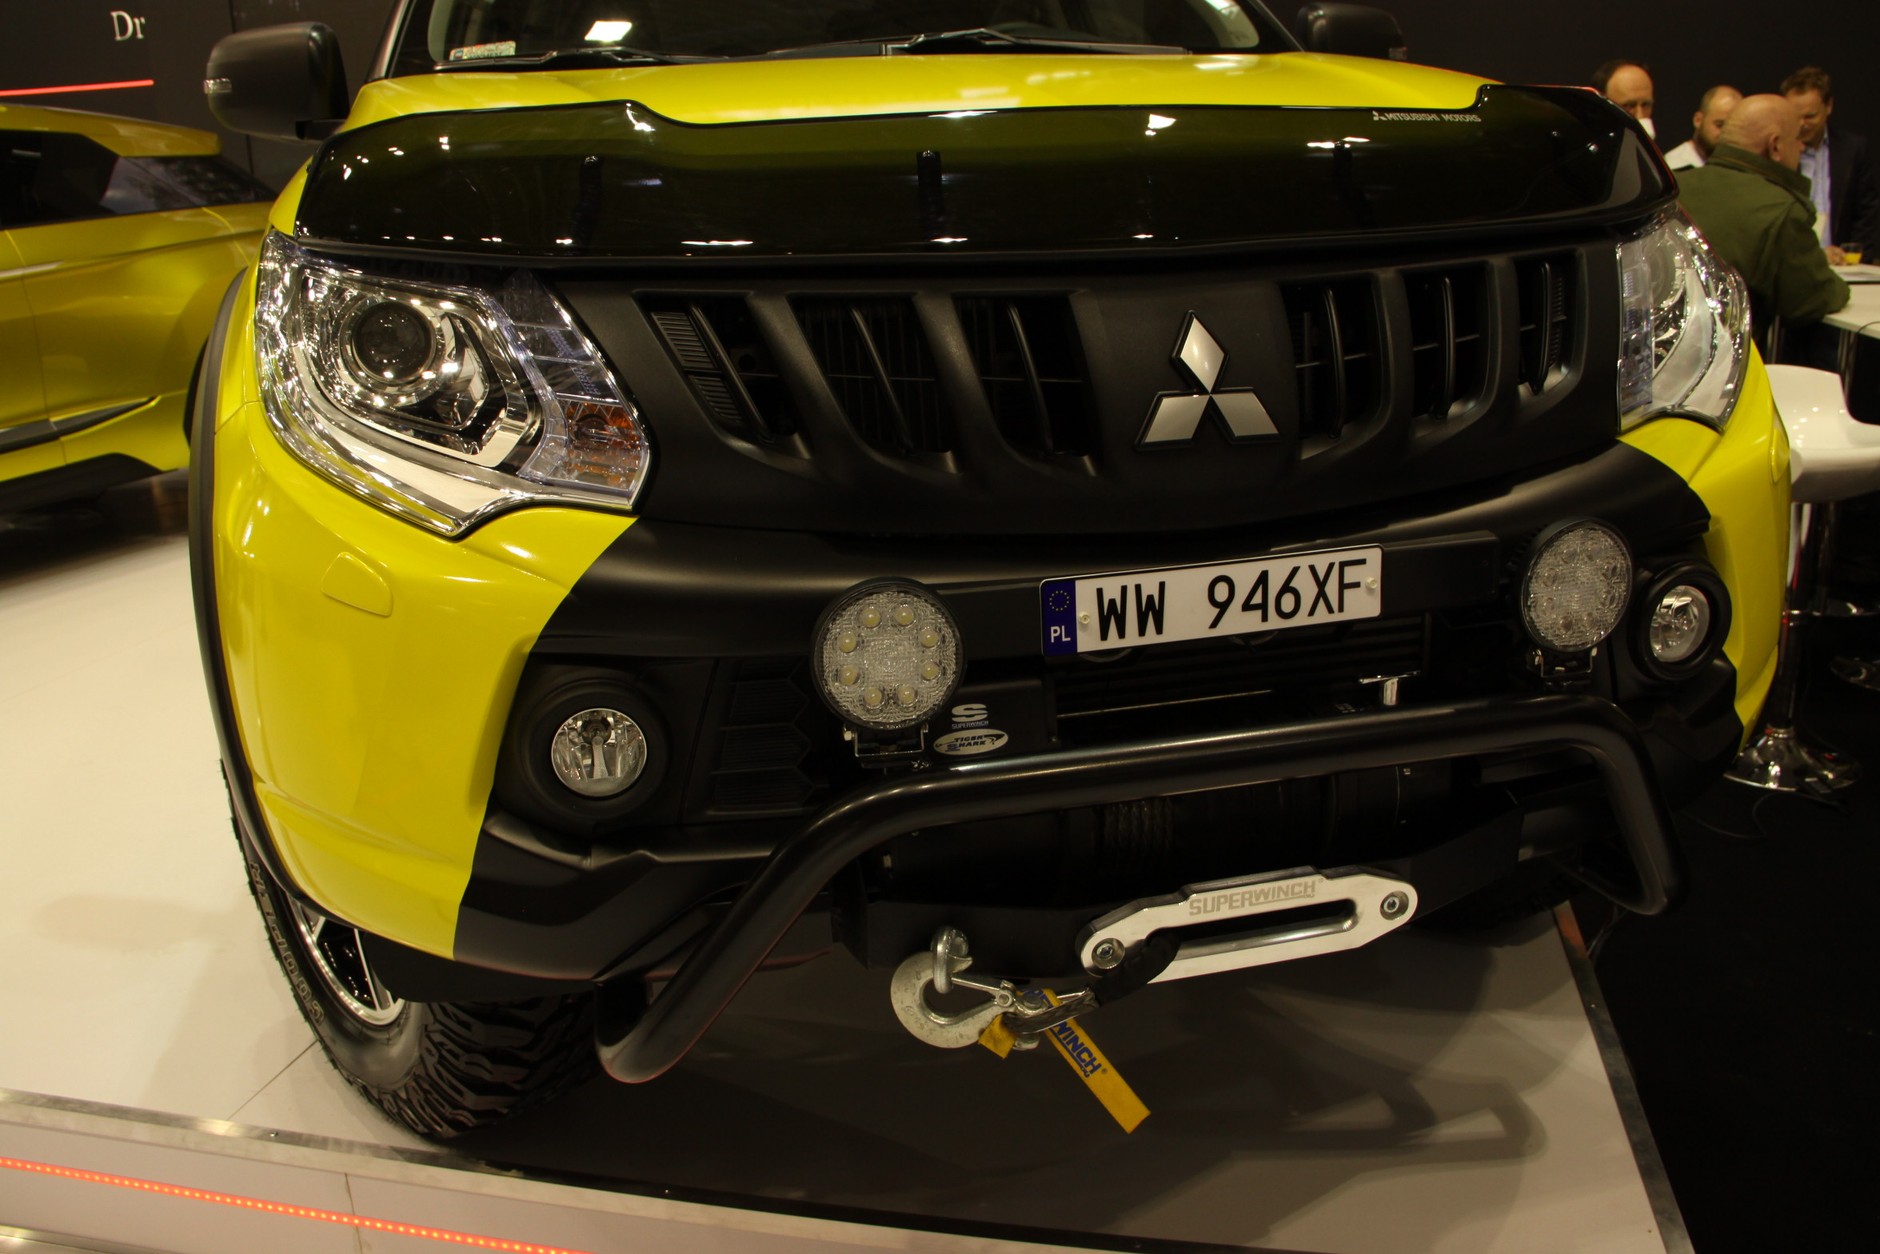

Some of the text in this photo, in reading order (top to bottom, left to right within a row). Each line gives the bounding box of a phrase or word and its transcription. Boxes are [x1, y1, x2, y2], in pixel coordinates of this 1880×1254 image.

[110, 10, 146, 41] Dr
[1384, 112, 1482, 122] MITSUBISHI MOTORS
[1096, 557, 1368, 642] WW 946XF
[1050, 625, 1072, 644] PL
[953, 735, 984, 743] TIGER
[1188, 879, 1317, 917] SUPERWINCH
